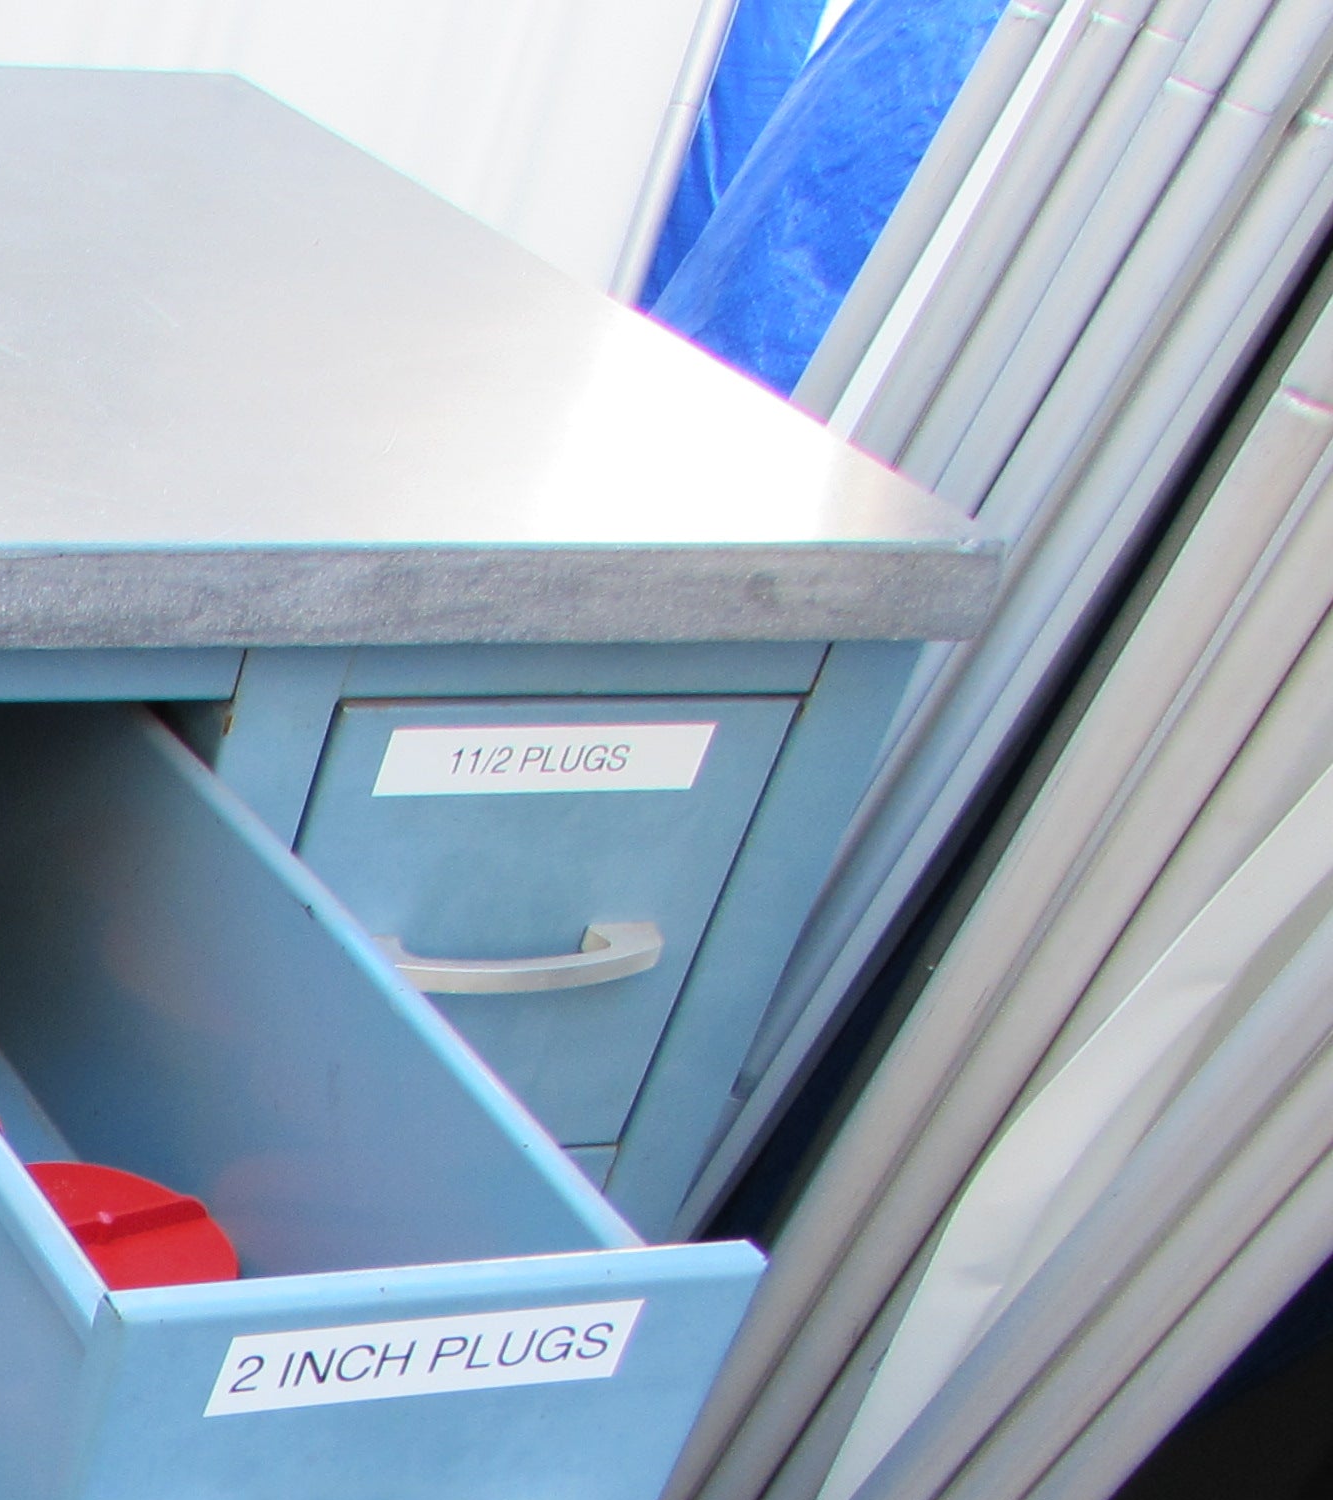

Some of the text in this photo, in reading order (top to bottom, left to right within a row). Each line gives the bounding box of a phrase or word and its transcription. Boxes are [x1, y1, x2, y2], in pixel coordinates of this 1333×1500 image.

[518, 744, 632, 774] PLUGS
[228, 1322, 615, 1394] 2 INCH PLUGS
